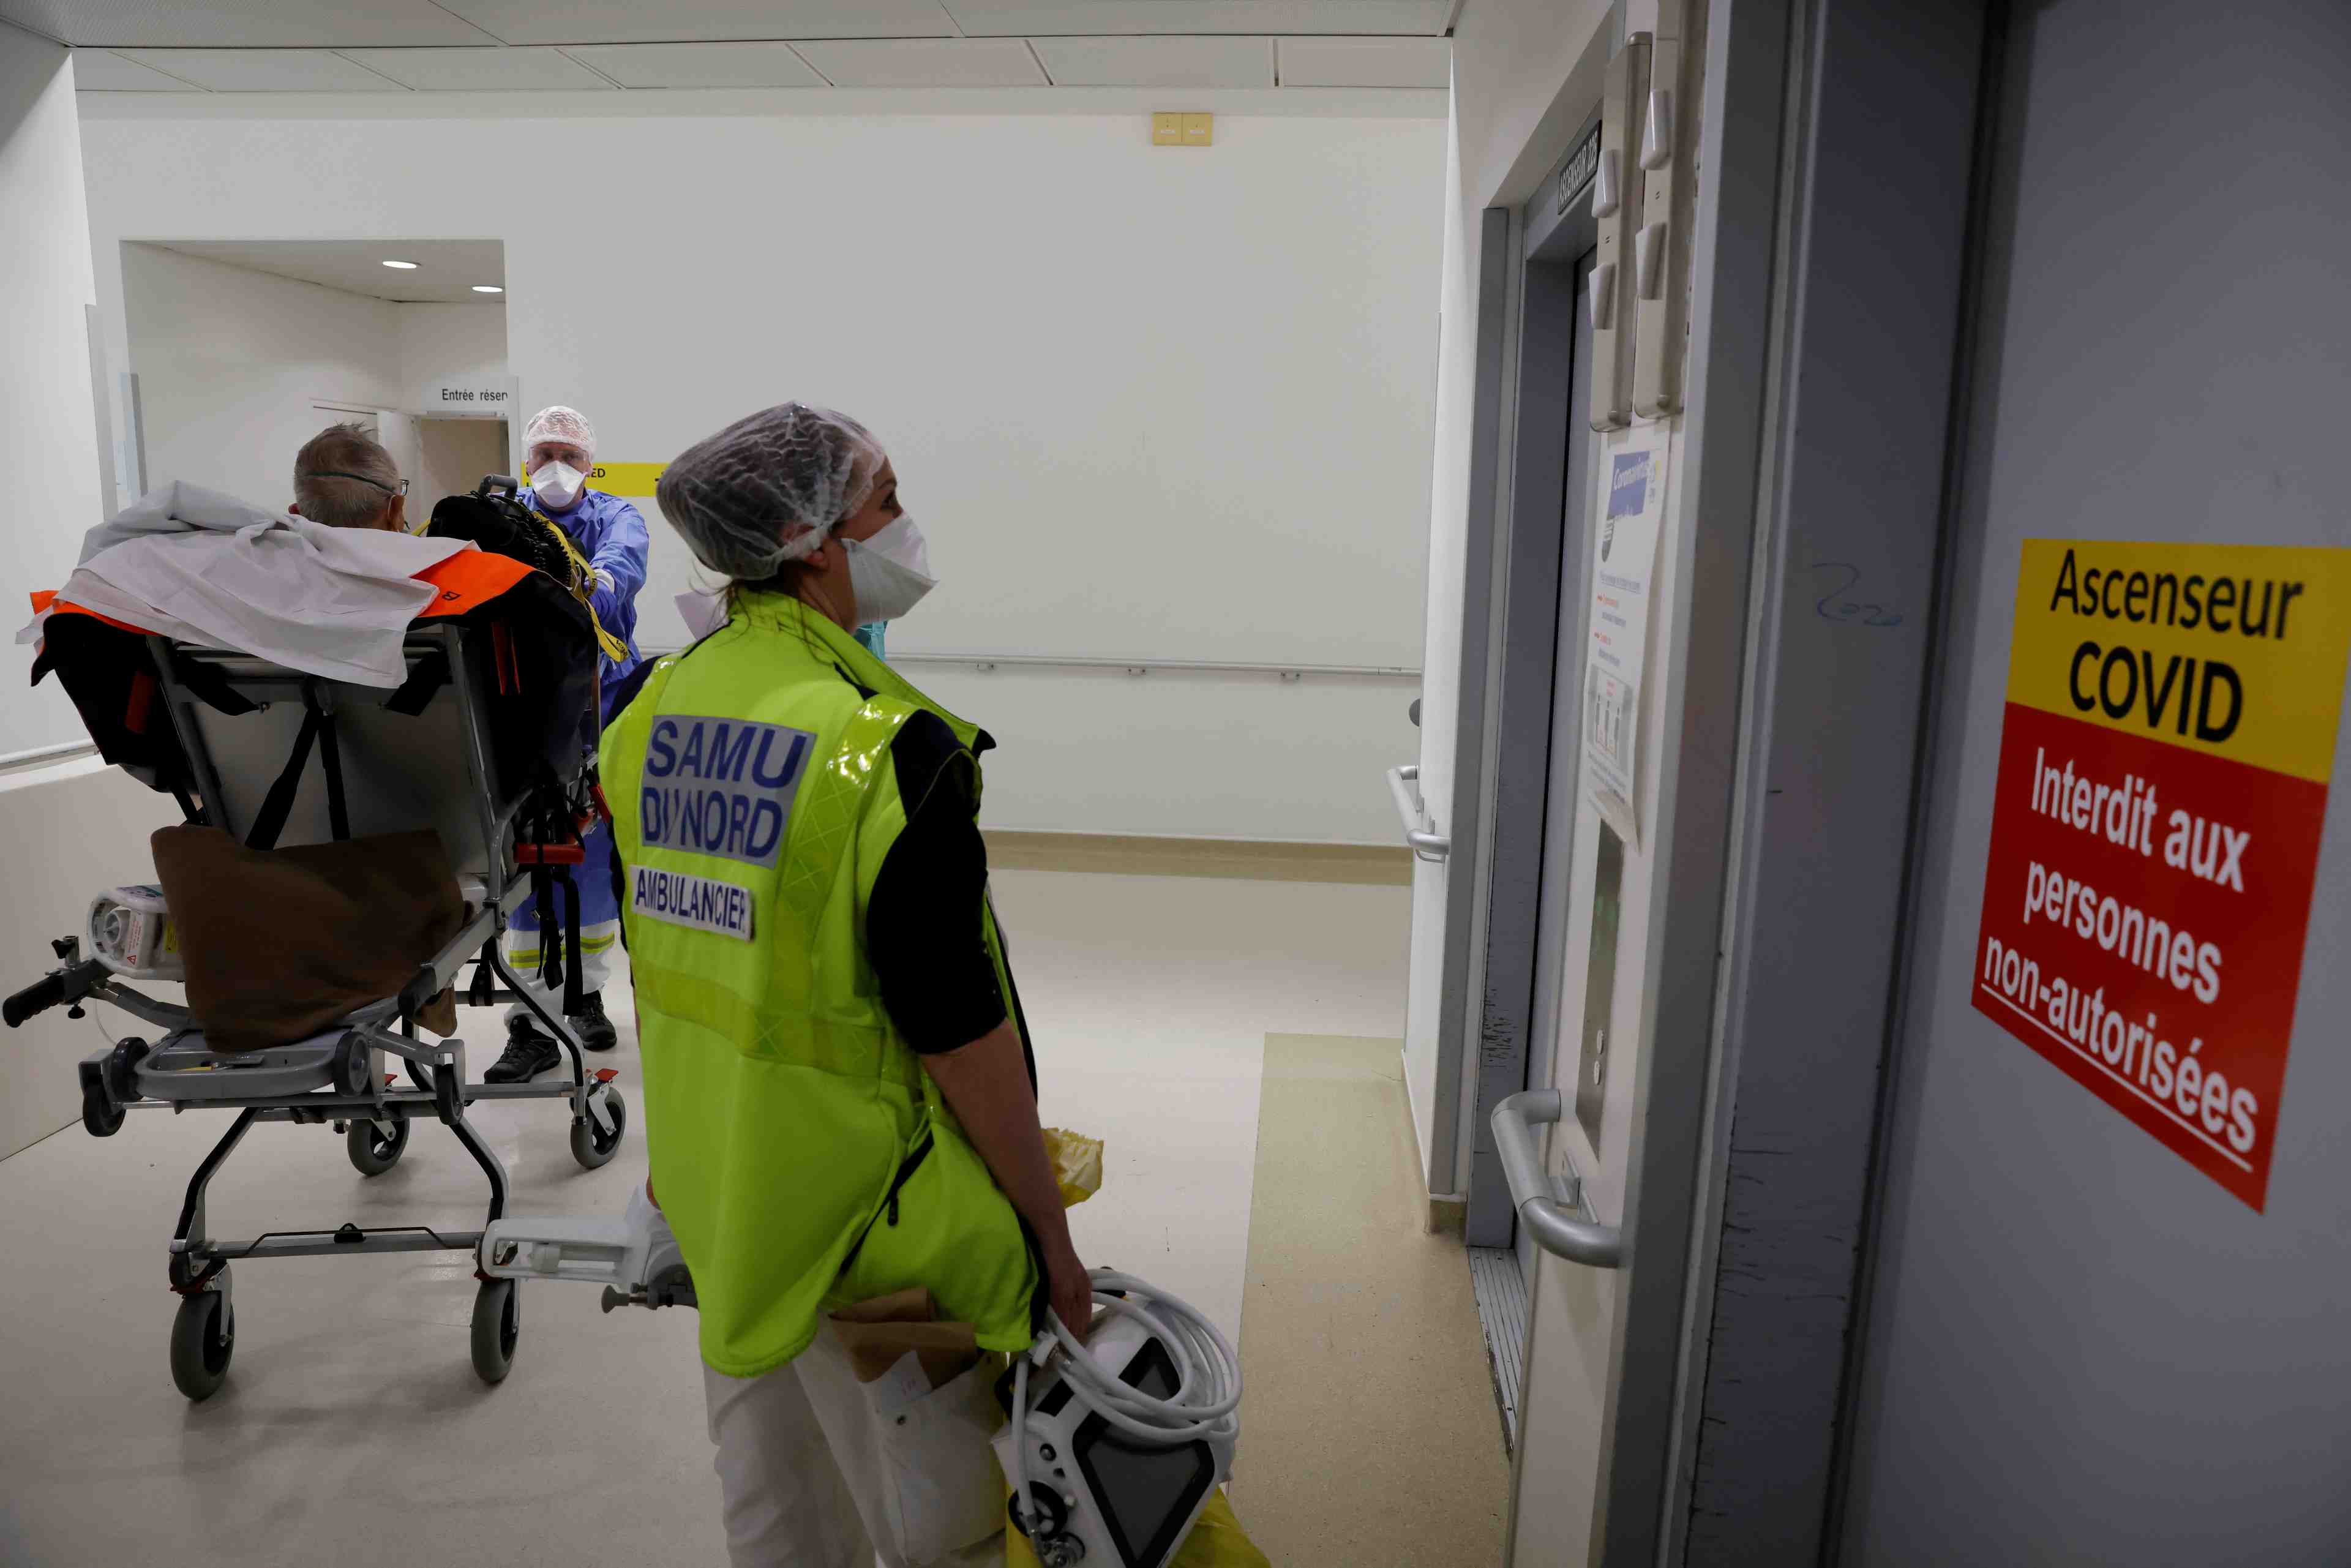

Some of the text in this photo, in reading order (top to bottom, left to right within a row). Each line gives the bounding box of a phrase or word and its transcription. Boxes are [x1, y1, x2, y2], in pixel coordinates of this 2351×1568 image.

[442, 388, 474, 401] Entrée
[2050, 548, 2305, 640] Ascenseur
[2069, 640, 2243, 743] COVID
[647, 720, 807, 788] SAMU
[680, 789, 783, 859] NORD
[2031, 746, 2251, 893] Interdit aux
[2023, 860, 2223, 1004] personnes
[1984, 936, 2259, 1153] non-autorisées
